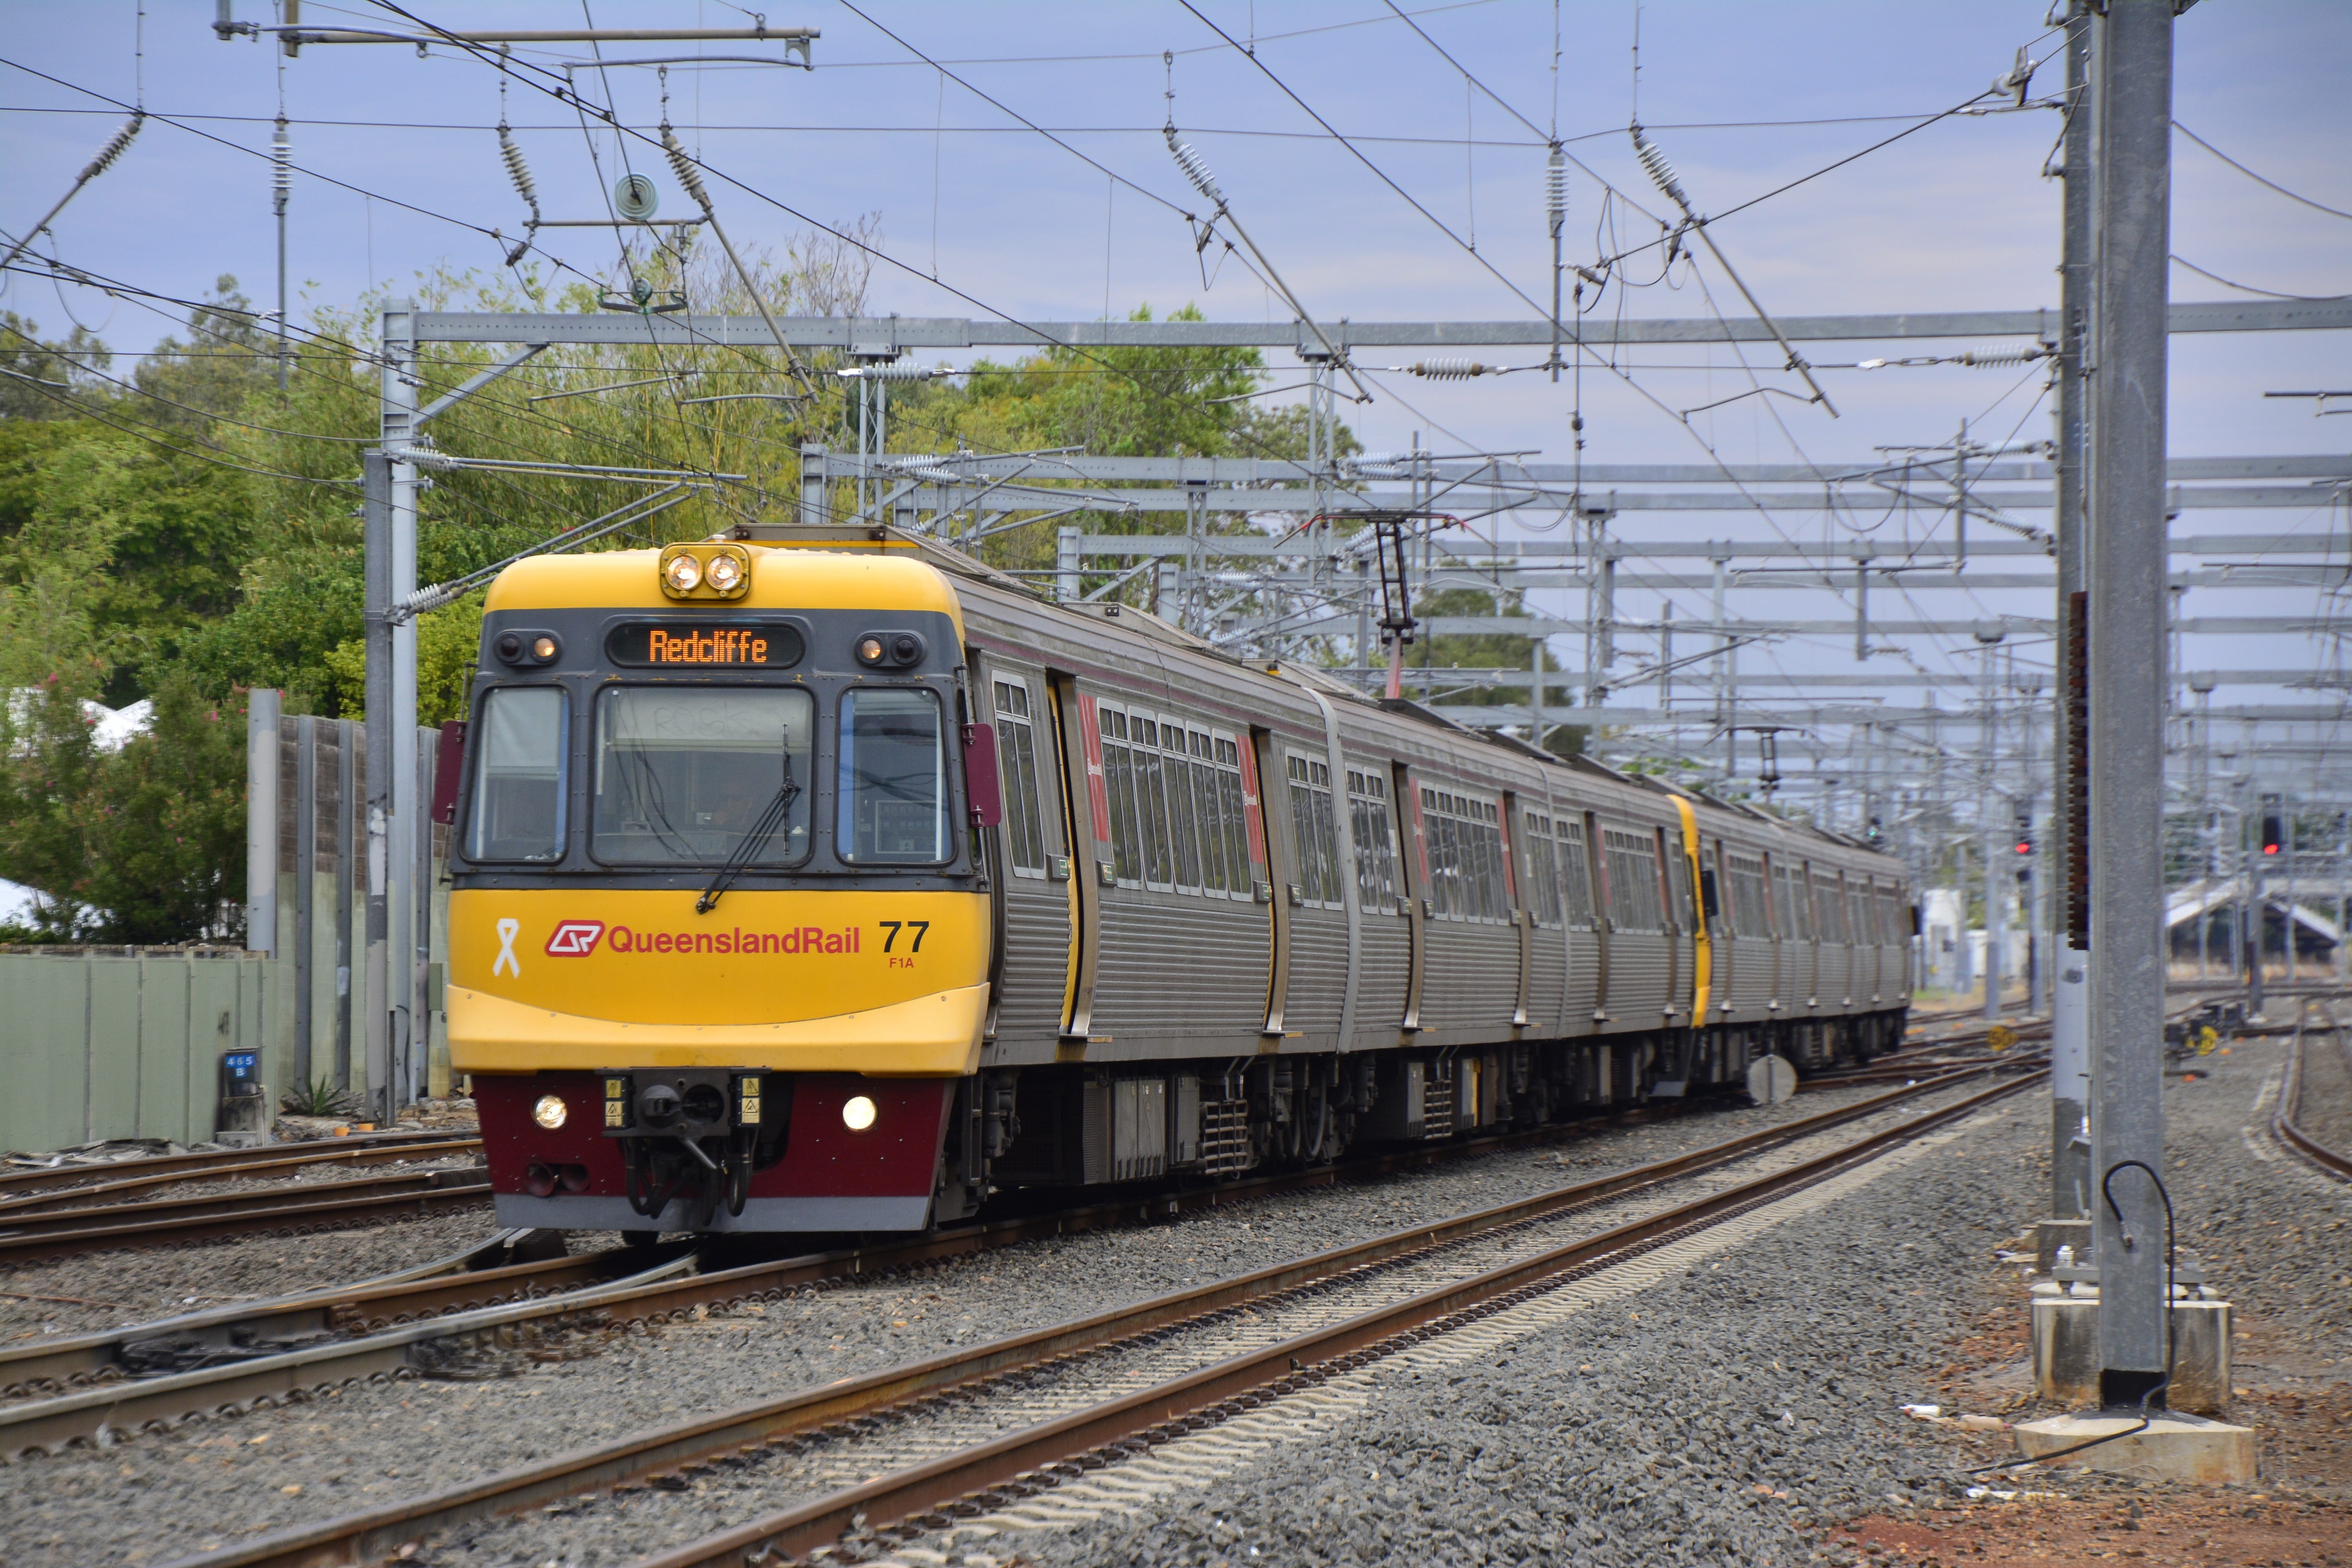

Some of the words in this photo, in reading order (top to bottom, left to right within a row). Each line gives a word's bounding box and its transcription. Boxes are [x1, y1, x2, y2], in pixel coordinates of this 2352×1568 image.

[650, 630, 767, 663] Redcliffe
[608, 926, 859, 954] QueenslandRail
[879, 921, 929, 953] 77
[889, 958, 914, 968] F1A
[227, 1056, 253, 1065] 465
[236, 1068, 245, 1076] B
